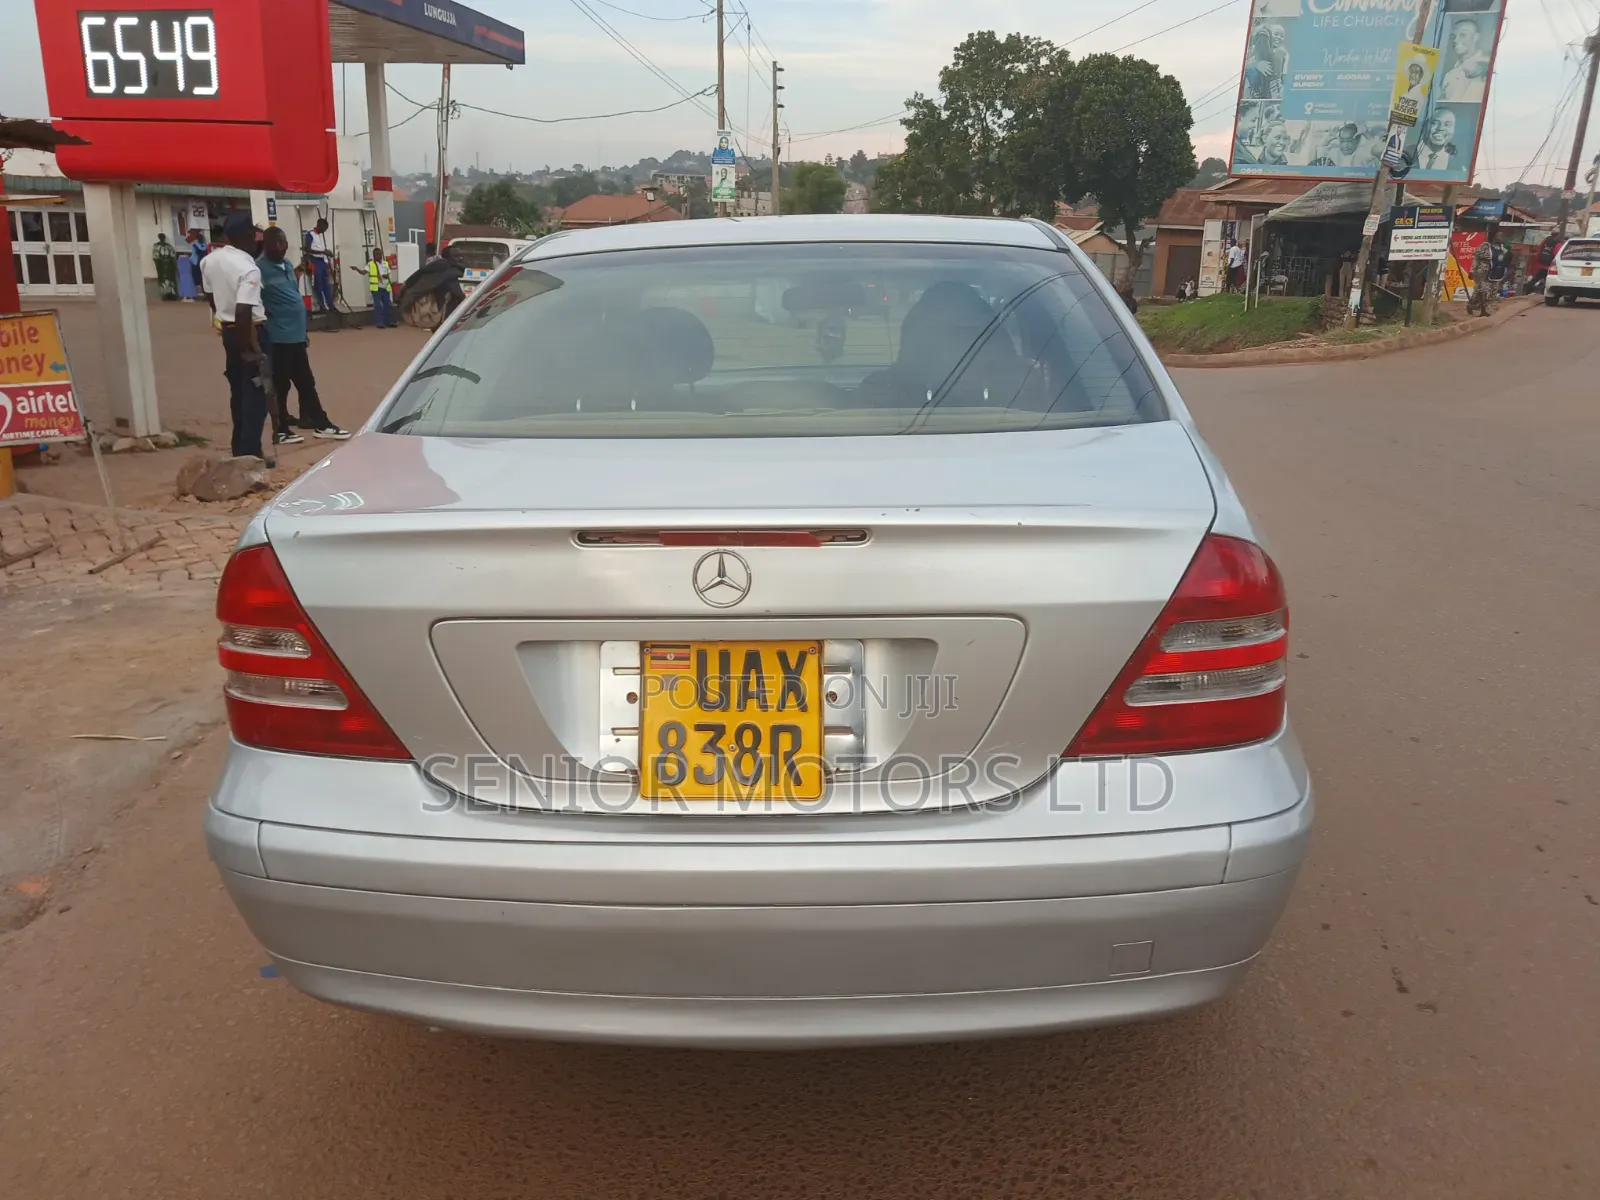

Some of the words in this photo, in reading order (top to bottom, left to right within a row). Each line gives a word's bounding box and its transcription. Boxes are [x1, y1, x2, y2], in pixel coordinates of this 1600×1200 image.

[1313, 15, 1340, 27] LIFE
[1343, 15, 1405, 27] CHURCH
[81, 16, 219, 95] 6549
[16, 390, 78, 415] airtel
[2, 431, 35, 440] AIRTIME
[36, 428, 60, 437] CARDS
[25, 415, 74, 431] money
[697, 649, 809, 713] UAX
[656, 721, 804, 787] 838R
